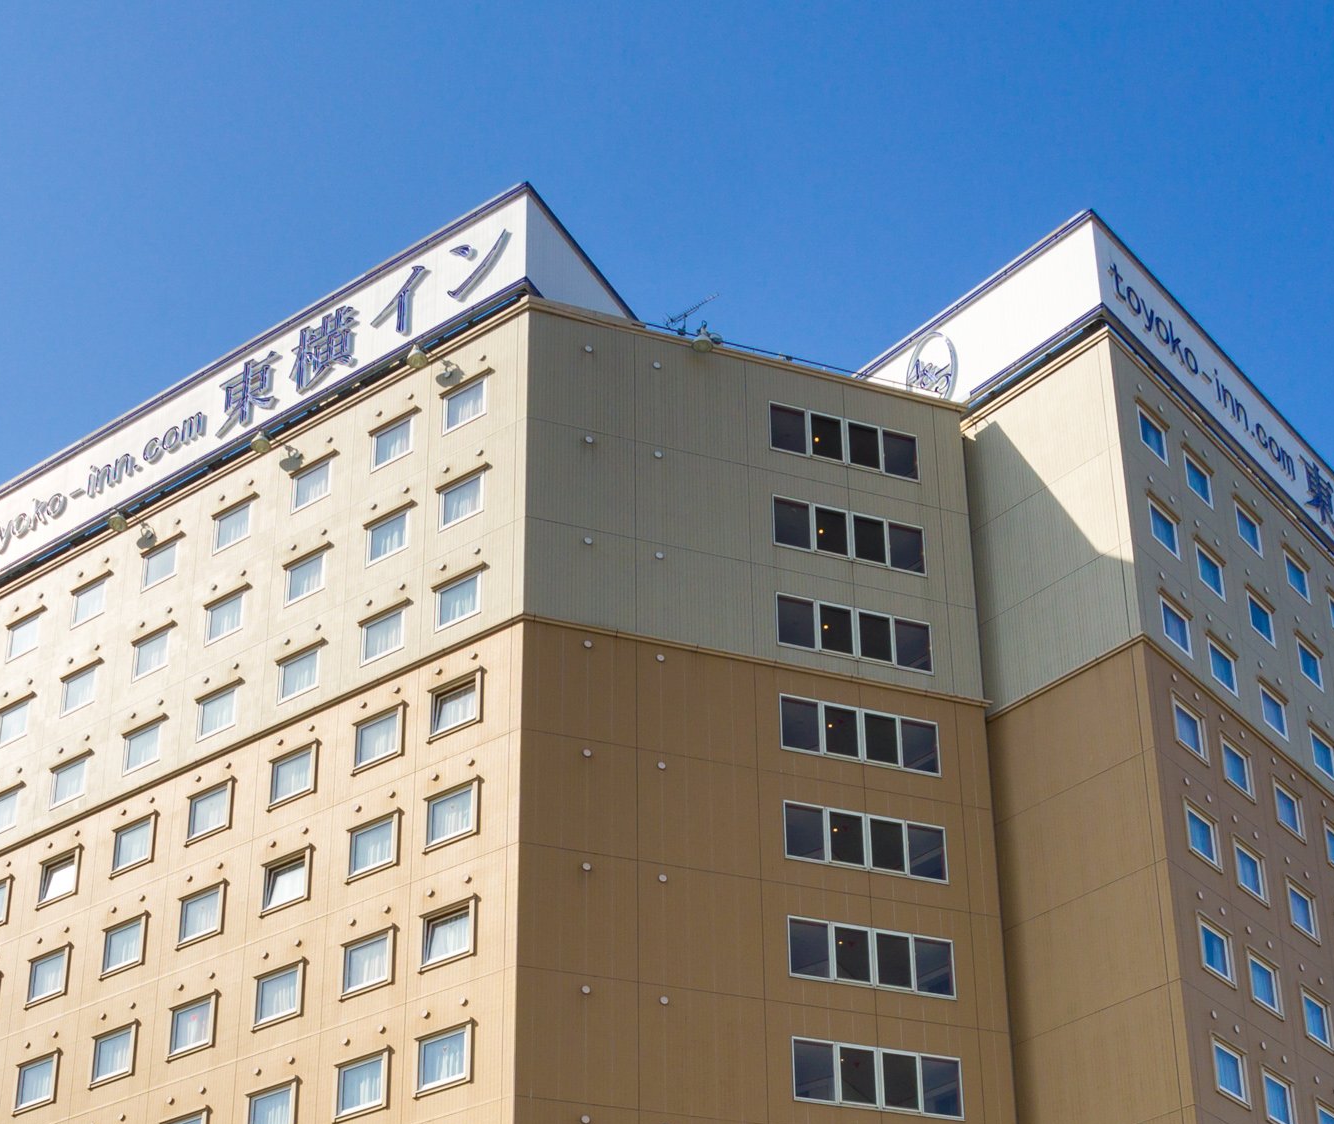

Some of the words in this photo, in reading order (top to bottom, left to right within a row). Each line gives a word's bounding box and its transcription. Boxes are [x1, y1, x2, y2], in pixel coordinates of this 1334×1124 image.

[215, 228, 513, 438] 東横イン
[1109, 263, 1295, 482] toyoko-inn.com
